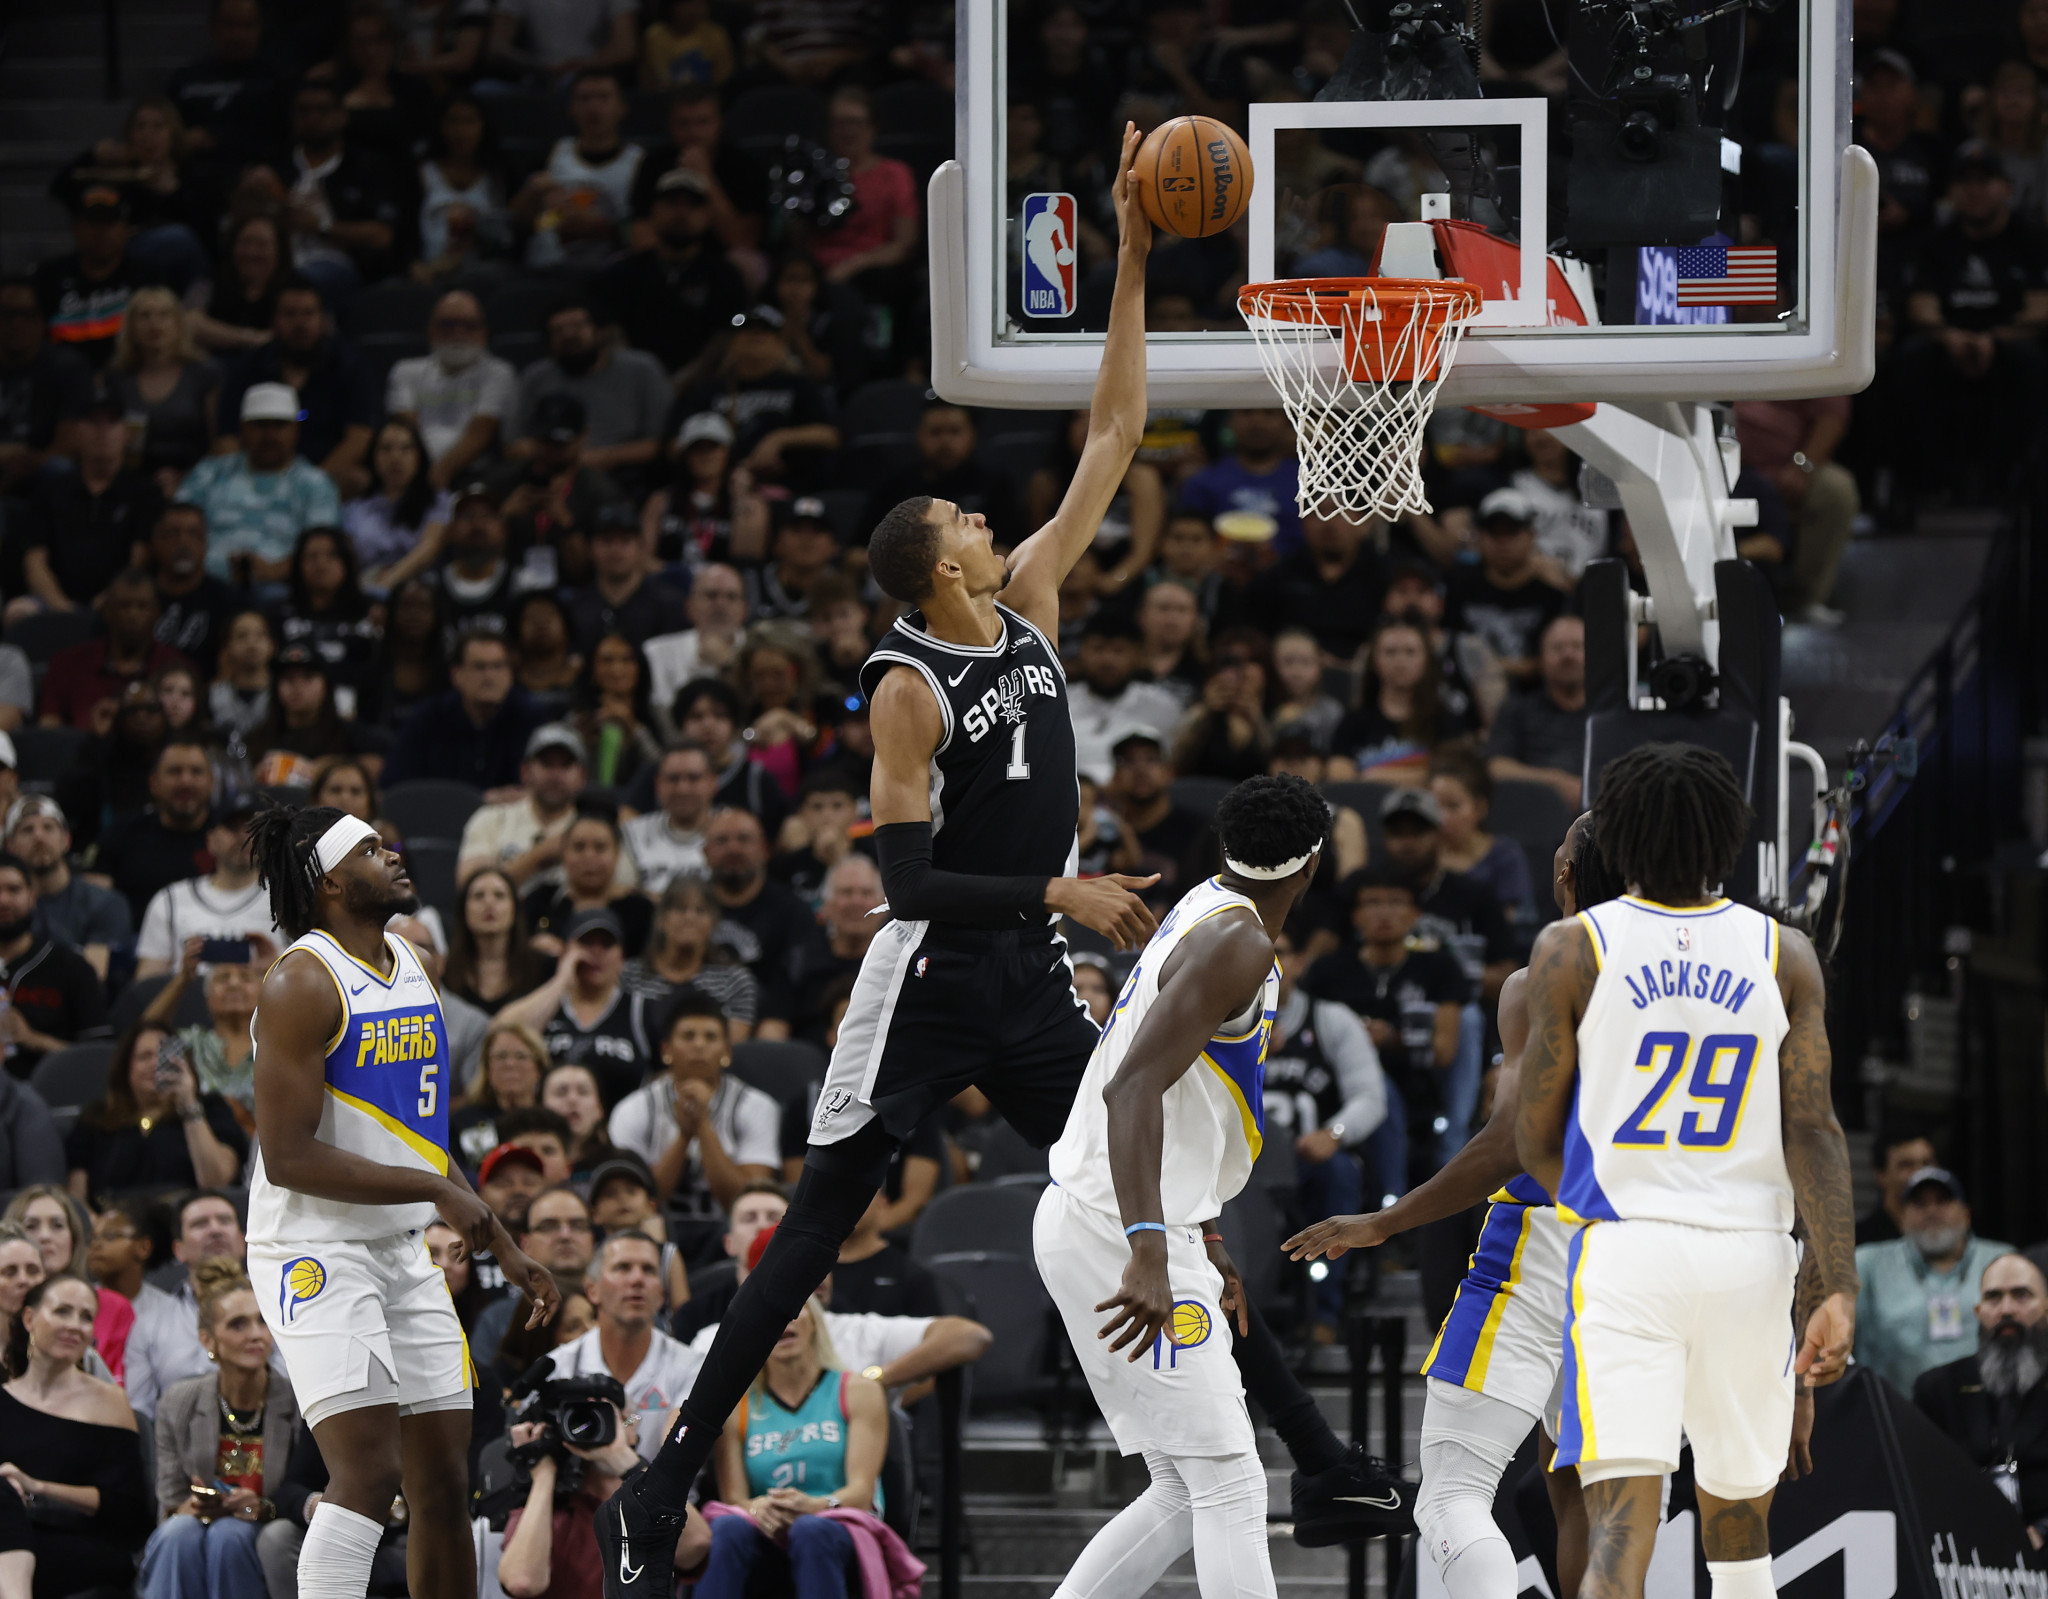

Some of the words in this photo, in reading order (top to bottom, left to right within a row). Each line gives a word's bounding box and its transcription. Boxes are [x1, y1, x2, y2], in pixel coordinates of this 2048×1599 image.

[1207, 139, 1234, 221] Wilson
[1030, 289, 1056, 309] NBA
[1011, 635, 1033, 649] LEDGER
[962, 664, 1058, 744] SPURS
[1006, 720, 1031, 780] 1
[1624, 959, 1756, 1015] JACKSON
[356, 1013, 437, 1067] PACERS
[417, 1064, 439, 1118] 5
[1612, 1031, 1763, 1152] 29
[747, 1420, 840, 1458] SPURS
